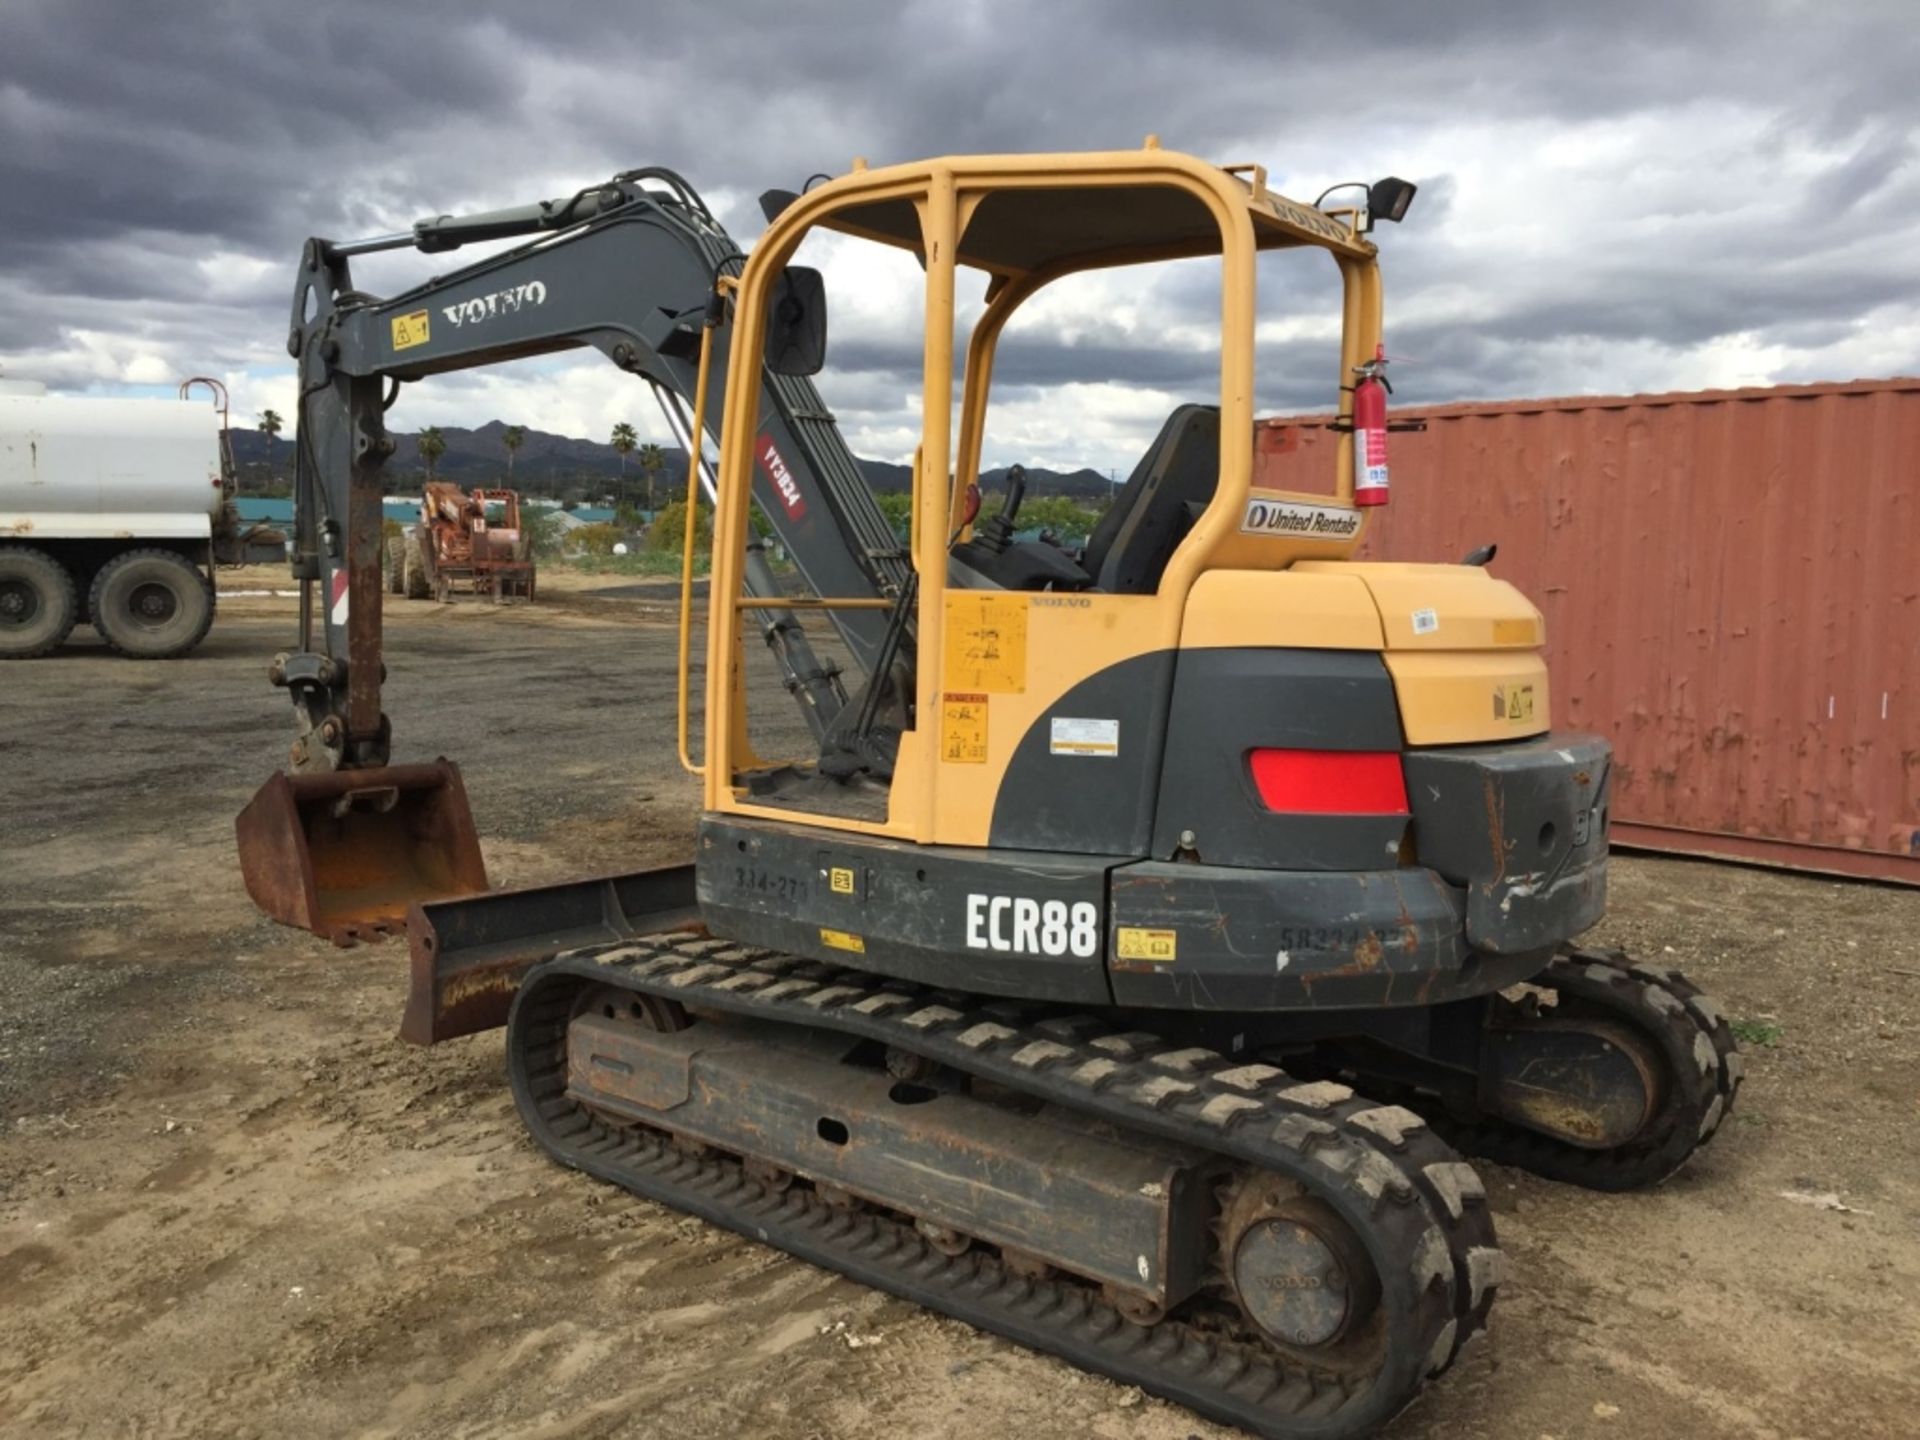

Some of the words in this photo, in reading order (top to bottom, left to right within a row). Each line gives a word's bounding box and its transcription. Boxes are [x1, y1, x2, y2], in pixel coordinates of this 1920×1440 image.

[1271, 201, 1347, 242] VOLVO
[442, 281, 546, 327] VOLVO
[1267, 508, 1314, 531] United
[1311, 512, 1358, 534] Rentals
[1030, 597, 1092, 608] VOLVO
[967, 894, 1097, 957] ECR88
